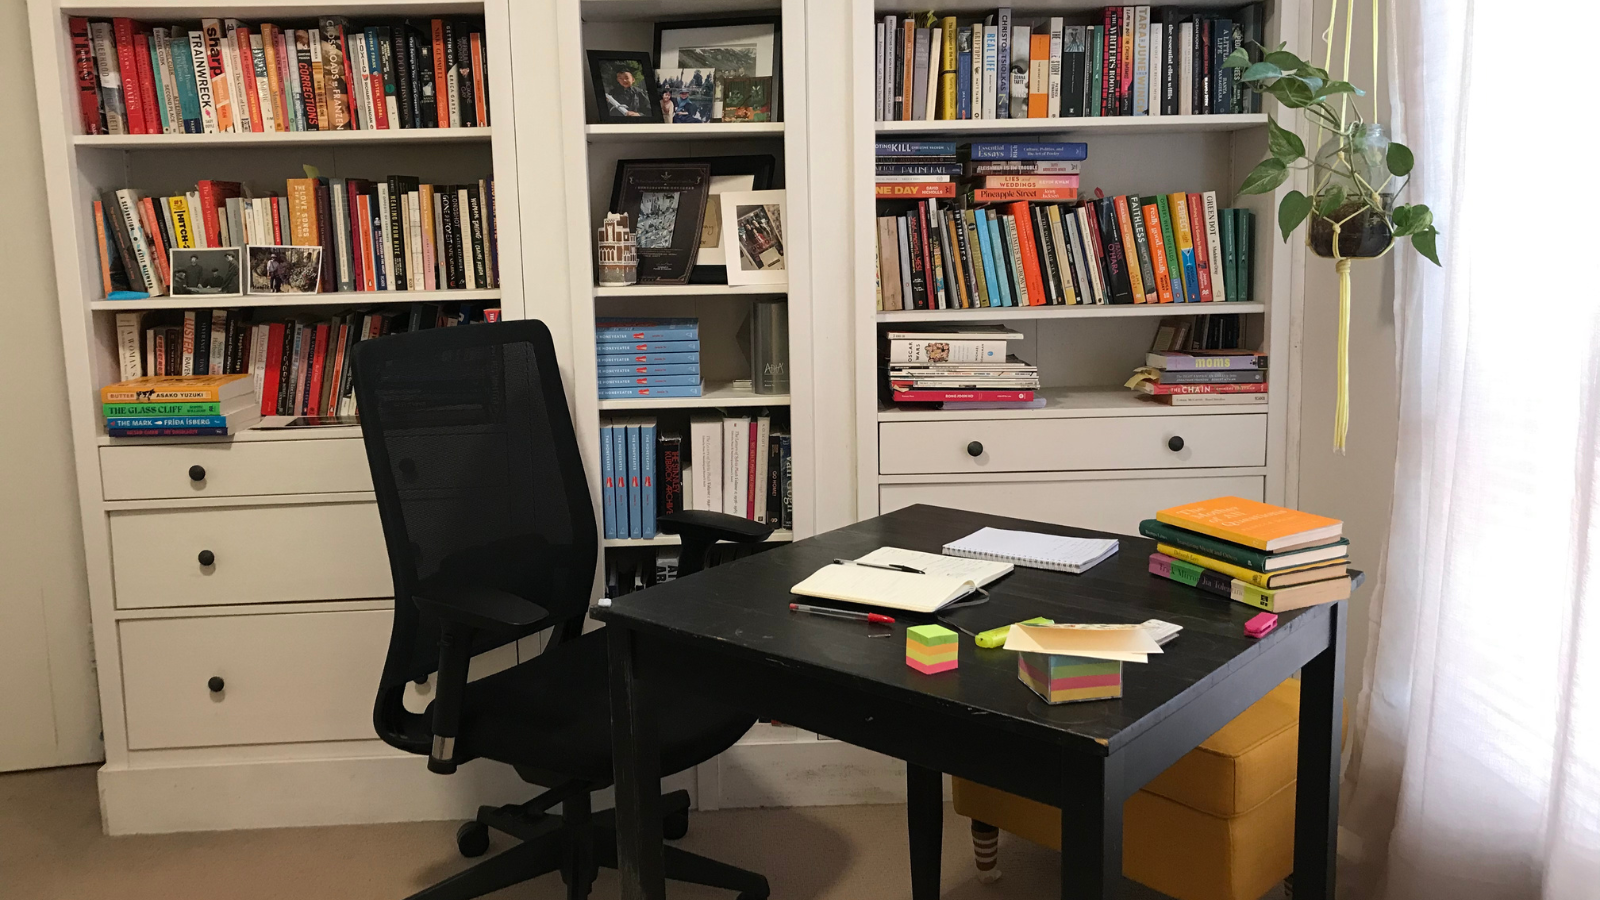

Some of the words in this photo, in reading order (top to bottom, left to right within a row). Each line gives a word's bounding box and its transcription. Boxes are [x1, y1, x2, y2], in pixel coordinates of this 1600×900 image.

[1052, 31, 1060, 39] THE
[1139, 8, 1147, 39] TARA
[207, 28, 224, 76] sharp
[986, 34, 995, 52] REAL
[1138, 43, 1146, 71] JUNE
[72, 27, 96, 95] TRUST
[155, 30, 164, 50] RACHEL
[164, 84, 172, 105] SECOND
[191, 34, 211, 108] TRAINWRECK
[326, 20, 339, 79] CROSSROADS
[333, 90, 343, 130] FRANZEN
[986, 56, 995, 71] LIFE
[1051, 61, 1059, 75] STORY
[95, 29, 109, 76] MOTHERHOOD
[110, 115, 118, 131] HETI
[125, 78, 136, 110] COATES
[298, 63, 317, 125] CORRECTIONS
[1137, 76, 1146, 112] WINCH
[175, 96, 183, 128] AFTERMATH
[891, 144, 911, 152] KILL
[902, 166, 929, 174] PAULINE
[980, 191, 1014, 199] Pineapple
[1206, 196, 1215, 220] GREEN
[1177, 200, 1188, 232] PERFECT
[955, 210, 966, 261] INTIMACIES
[1131, 197, 1145, 243] FAITHLESS
[1144, 264, 1152, 286] NELSON
[1151, 228, 1162, 248] good,
[1157, 249, 1166, 274] actually
[1165, 235, 1174, 262] EMERALDS
[1108, 243, 1119, 275] O'HARA
[183, 317, 194, 354] LUSTER
[258, 331, 266, 363] Attached
[1195, 358, 1230, 368] moms
[129, 406, 157, 414] GLASS
[664, 451, 673, 482] KUBRICK
[772, 471, 777, 479] GO
[1176, 506, 1205, 516] The
[1190, 506, 1240, 520] Mother
[1220, 509, 1288, 527] Questions
[1224, 511, 1246, 519] All
[1174, 550, 1190, 559] Deborah
[1190, 554, 1199, 562] Levy
[1159, 563, 1175, 573] Trick
[1177, 569, 1200, 582] Mirror
[1202, 576, 1212, 586] Jia
[1214, 580, 1243, 596] Tolentino
